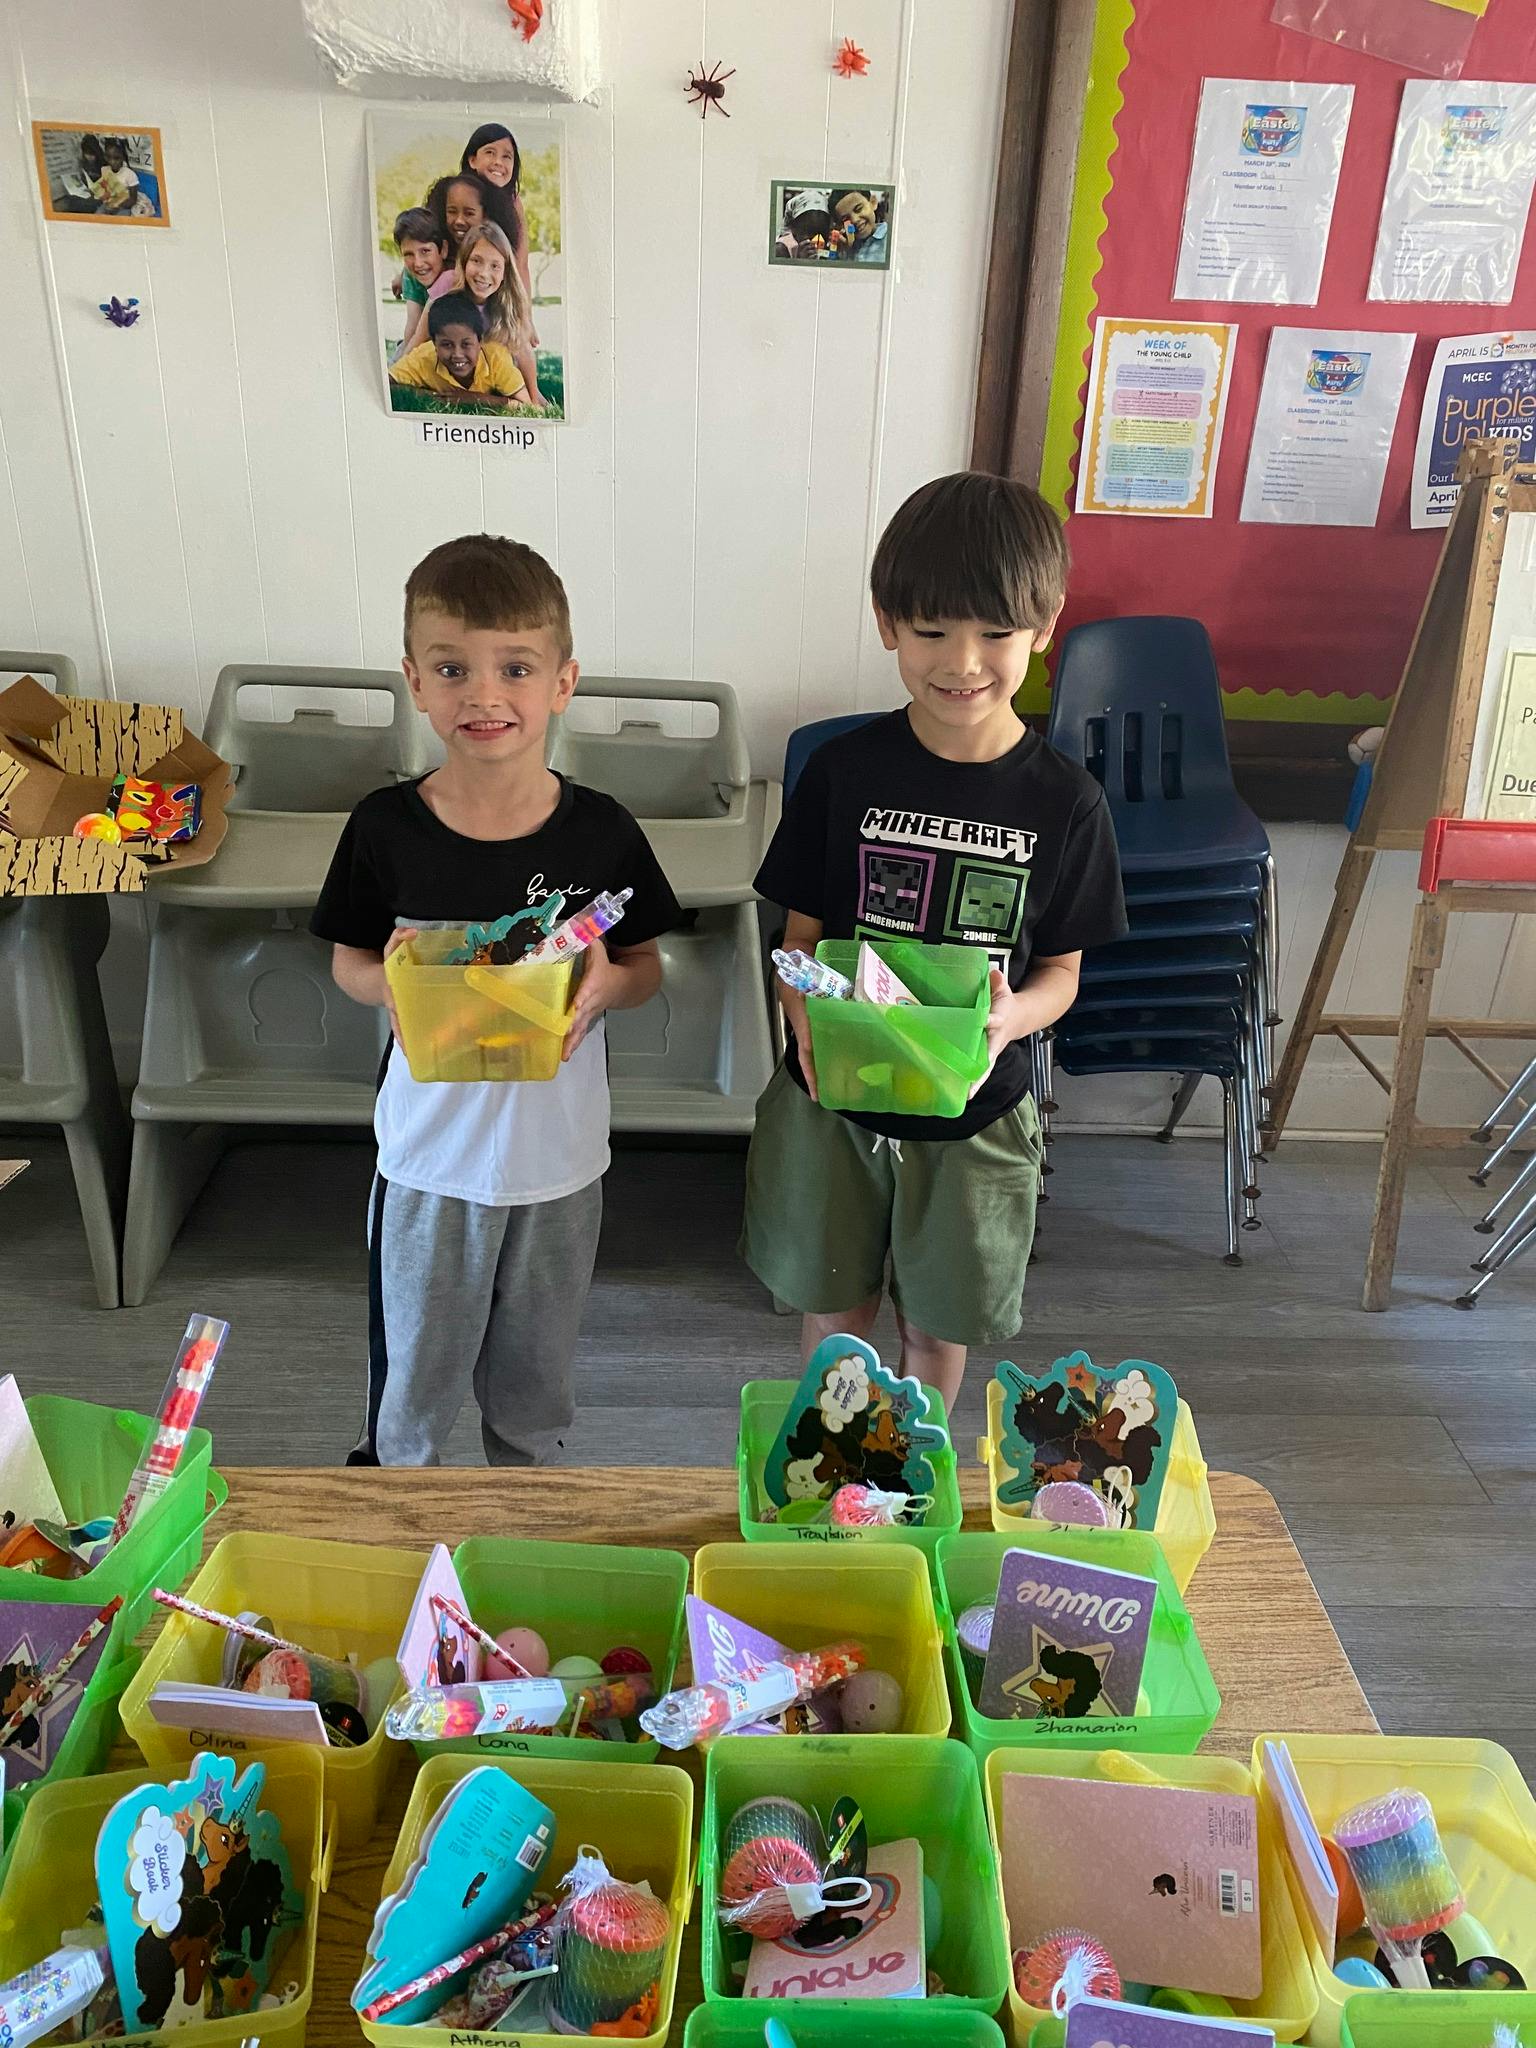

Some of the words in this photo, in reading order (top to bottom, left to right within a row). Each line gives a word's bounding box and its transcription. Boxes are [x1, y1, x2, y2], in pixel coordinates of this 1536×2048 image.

[1252, 118, 1299, 131] Easter
[1144, 339, 1171, 349] WEEK
[1173, 341, 1187, 350] OF
[1448, 348, 1477, 359] APRIL
[1479, 346, 1490, 356] IS
[1318, 360, 1364, 374] Easter
[1462, 371, 1493, 383] MCEC
[1496, 417, 1506, 425] for
[1508, 416, 1536, 425] military
[422, 421, 536, 450] Friendship
[1488, 425, 1534, 442] KIDS
[1430, 474, 1448, 483] Our
[1429, 489, 1458, 504] April
[1501, 773, 1536, 794] Due
[860, 808, 1038, 863] MINECRAFT
[864, 912, 915, 933] ENDERMAN
[962, 930, 998, 943] ZOMBIE
[1016, 1579, 1142, 1634] Divine
[1207, 1806, 1215, 1847] GARTNER
[154, 1842, 171, 1891] Sticker
[142, 1856, 159, 1894] Book
[750, 1951, 906, 1999] unique
[449, 2033, 521, 2048] Athena
